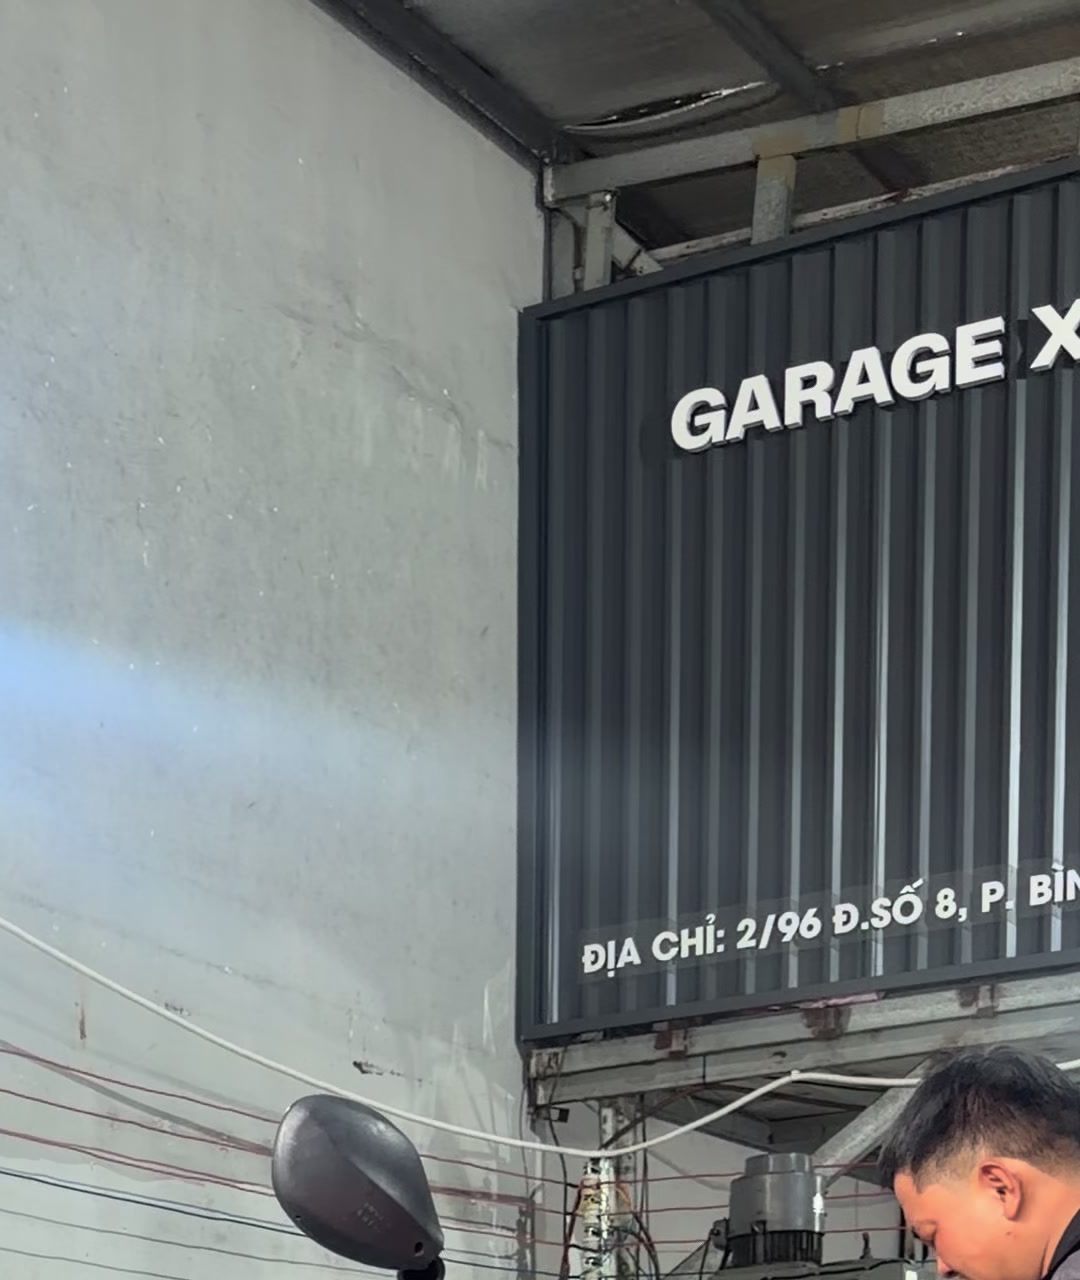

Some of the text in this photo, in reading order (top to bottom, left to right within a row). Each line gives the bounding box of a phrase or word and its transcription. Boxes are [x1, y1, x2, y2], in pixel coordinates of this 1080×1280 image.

[670, 316, 1006, 454] GARAGE
[581, 937, 642, 978] ĐỊA
[651, 913, 725, 962] CHỈ:
[736, 907, 822, 949] 2/96
[832, 878, 924, 934] Đ.SỐ
[934, 887, 968, 923] 8,
[980, 880, 1016, 913] P.
